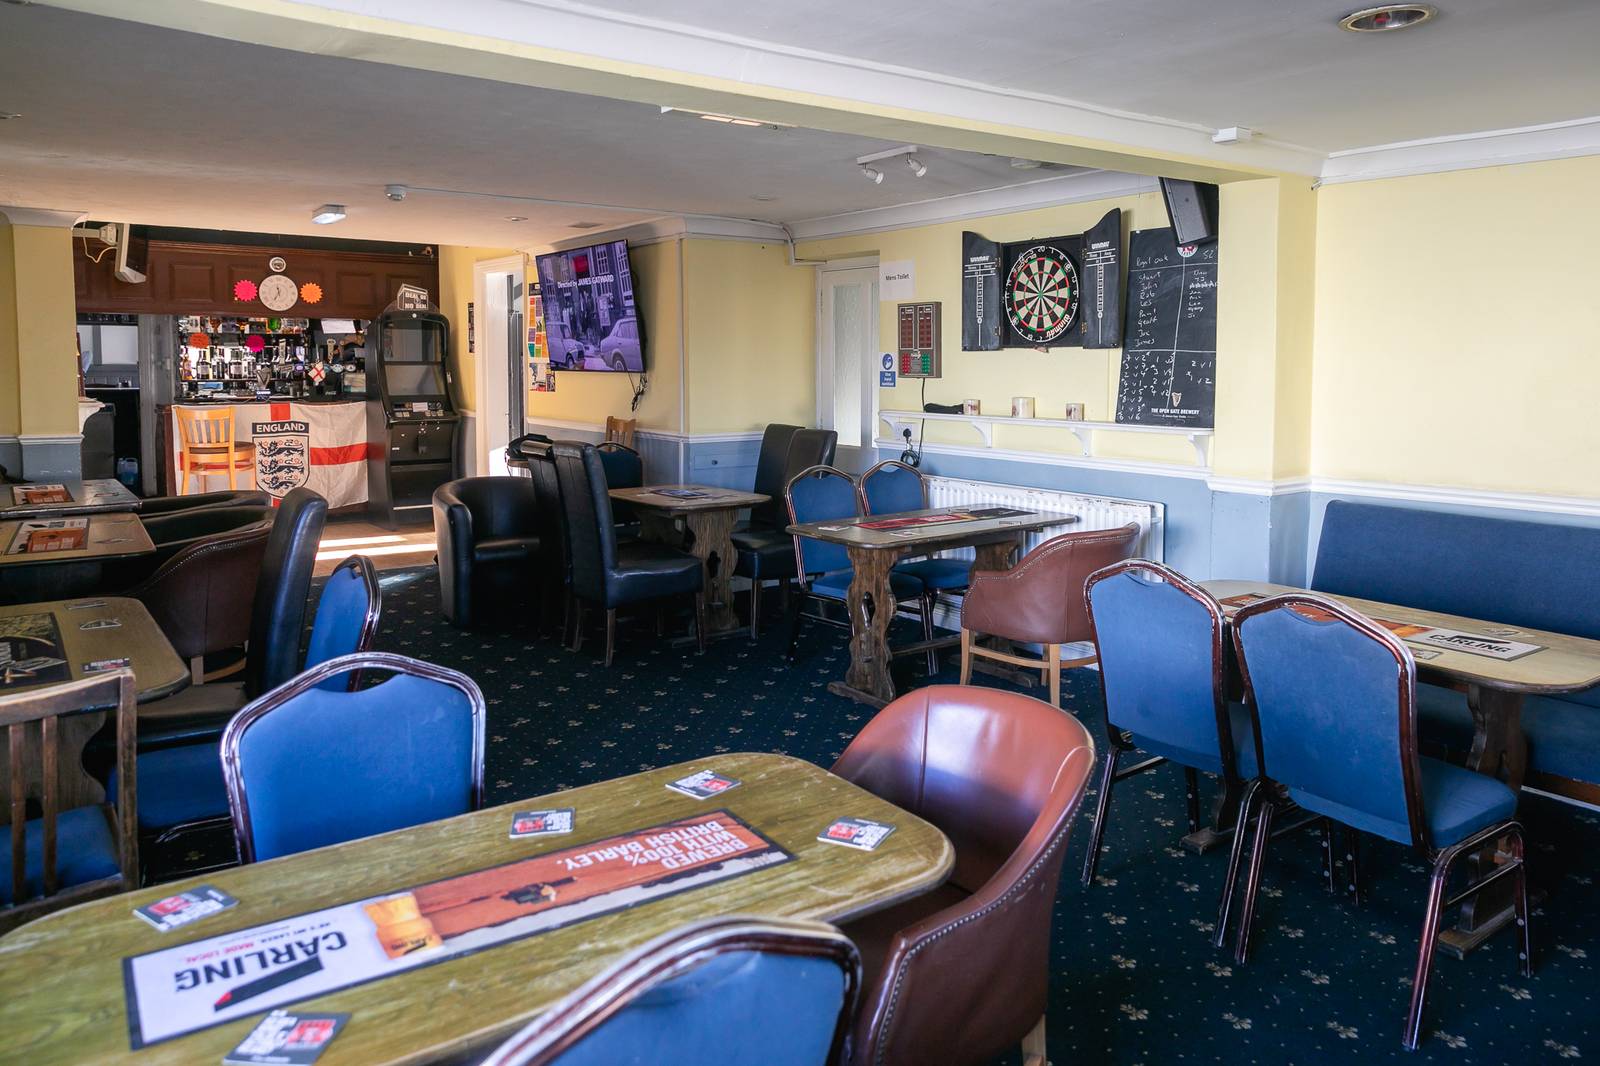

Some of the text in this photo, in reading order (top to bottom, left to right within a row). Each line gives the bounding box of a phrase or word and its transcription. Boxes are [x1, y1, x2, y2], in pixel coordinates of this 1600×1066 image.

[558, 280, 572, 288] Directed
[572, 280, 578, 288] by
[578, 276, 592, 286] JAMES
[256, 423, 305, 432] ENGLAND
[1430, 634, 1511, 652] CARLING
[556, 820, 724, 870] BRITISH BARLEY.
[624, 830, 737, 868] WITH 100%
[661, 839, 749, 869] BREWED
[174, 931, 348, 992] CARLING
